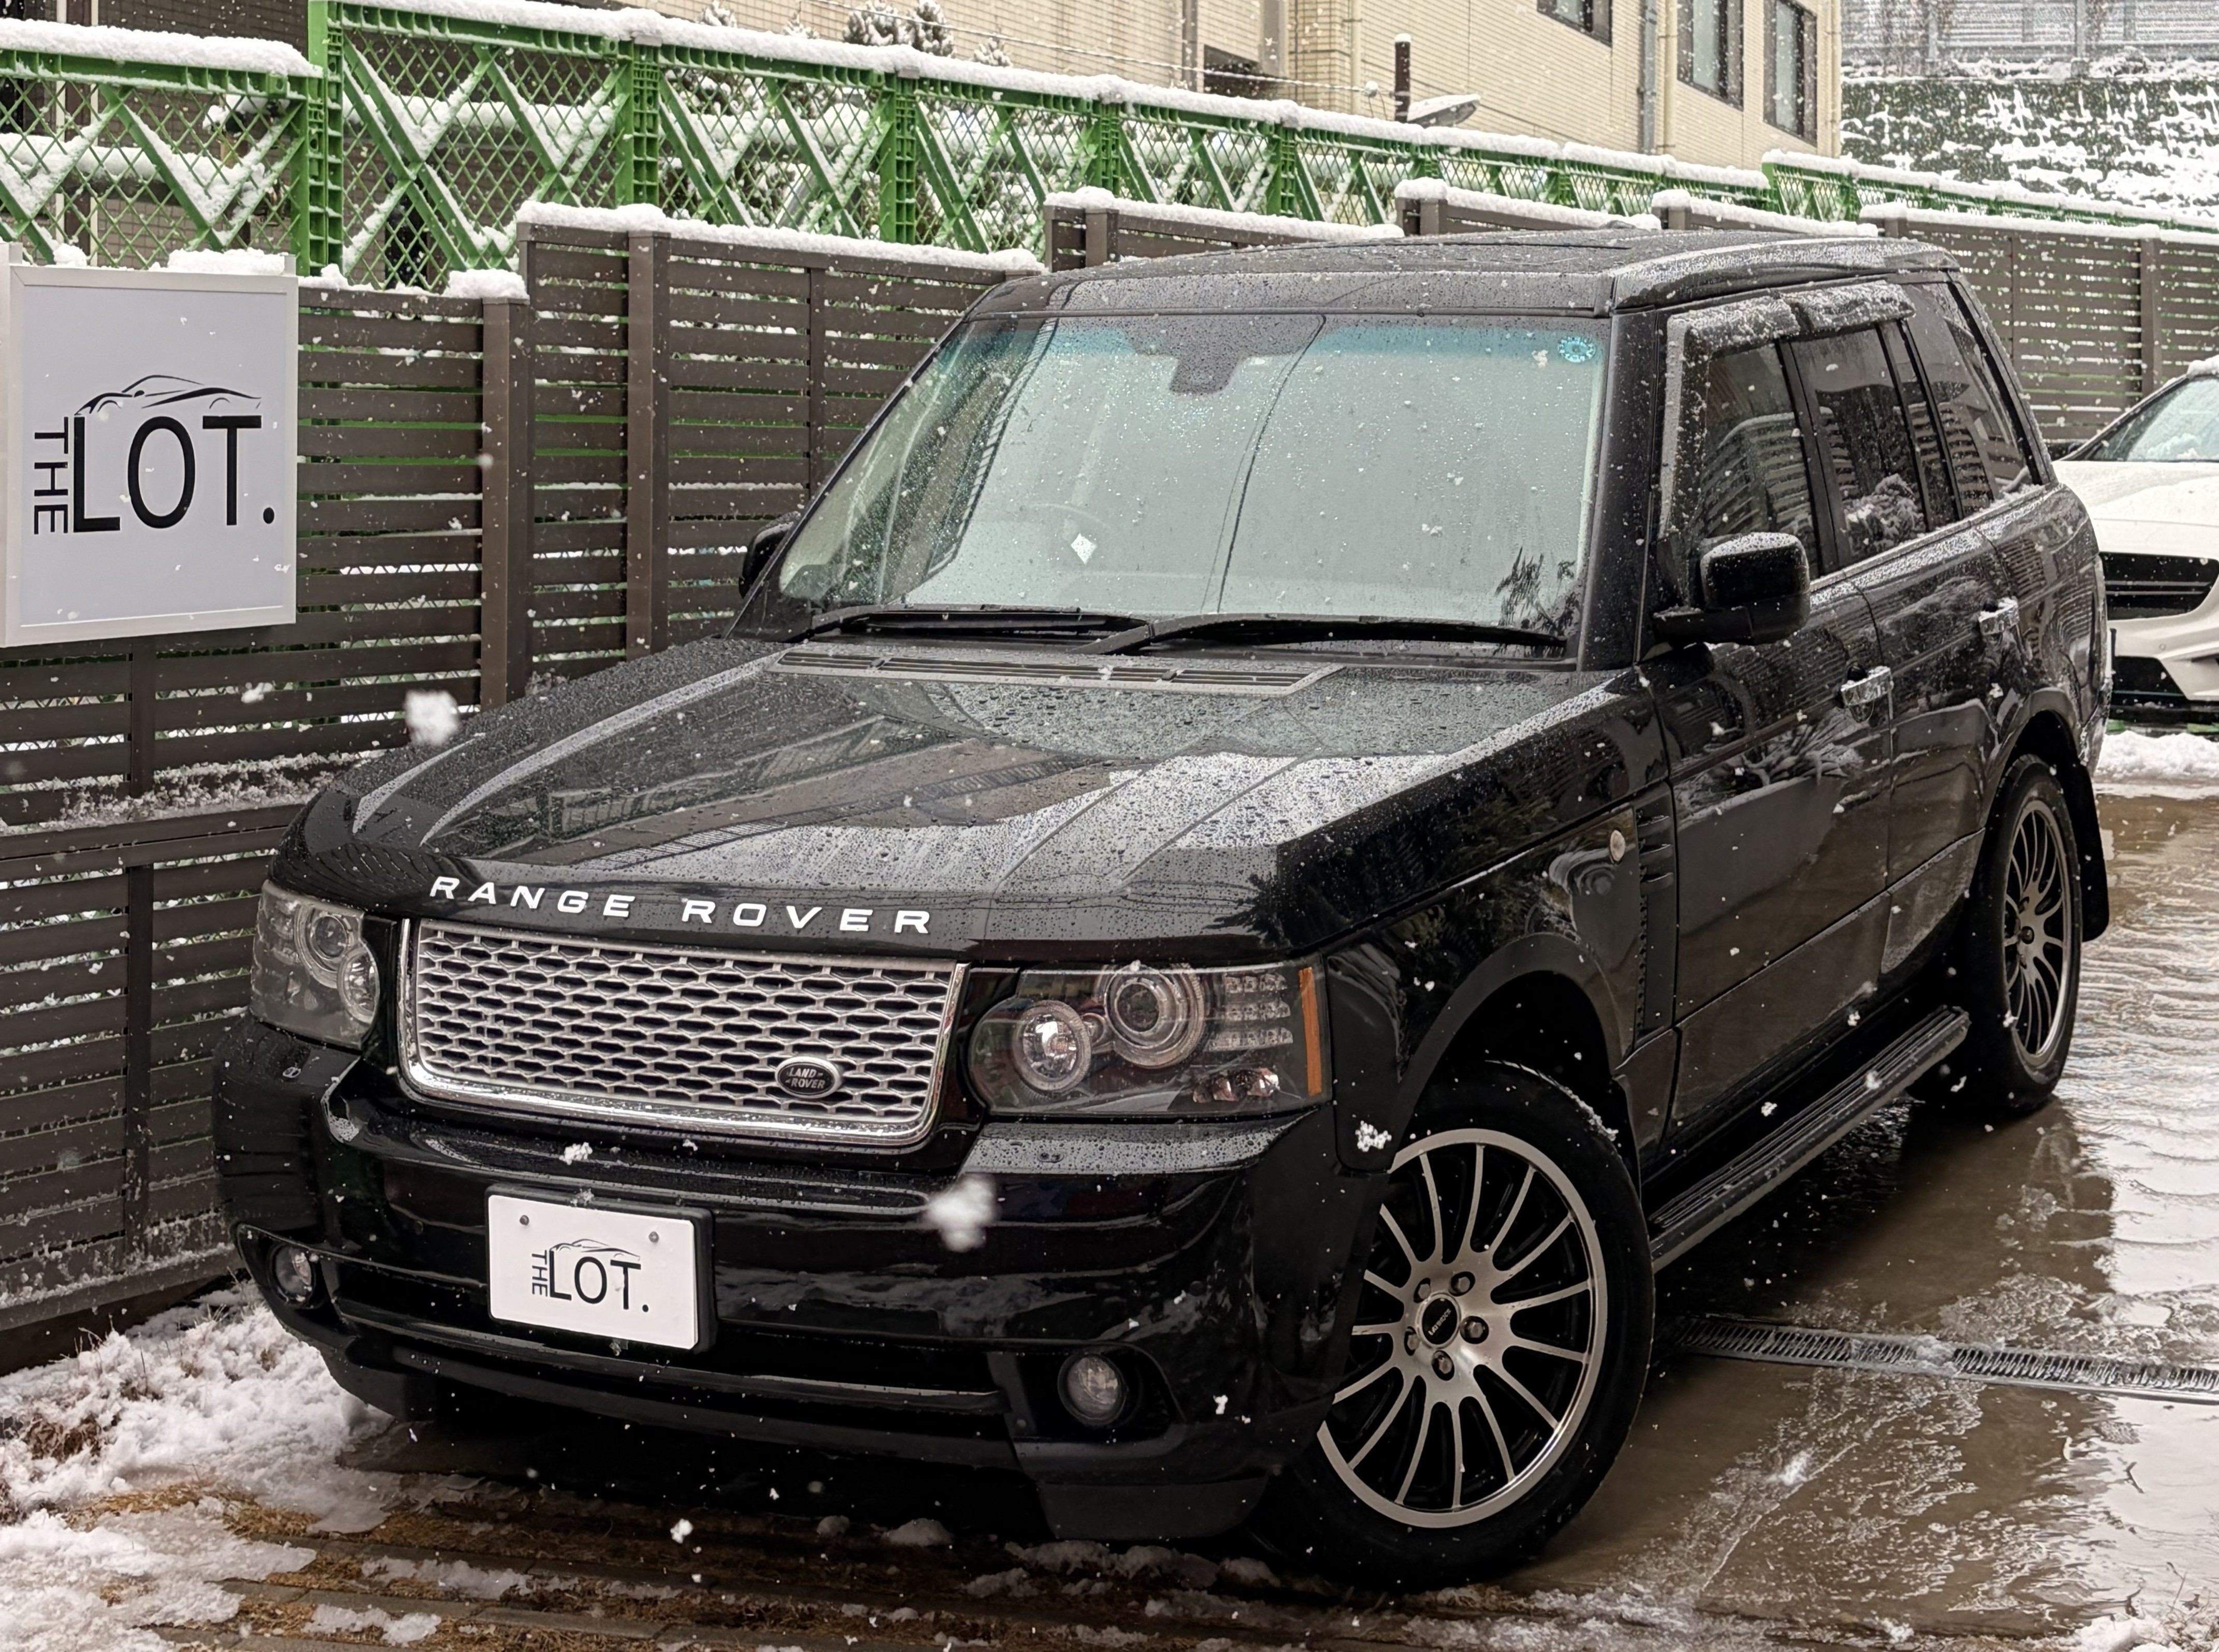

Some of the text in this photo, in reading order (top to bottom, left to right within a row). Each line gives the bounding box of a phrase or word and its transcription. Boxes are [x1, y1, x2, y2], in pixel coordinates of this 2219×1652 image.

[34, 416, 68, 534] THE
[74, 415, 275, 533] LOT.
[430, 876, 931, 934] RANGE ROVER
[791, 1078, 825, 1089] ROVER
[531, 1250, 548, 1297] THE
[549, 1251, 650, 1313] LOT.
